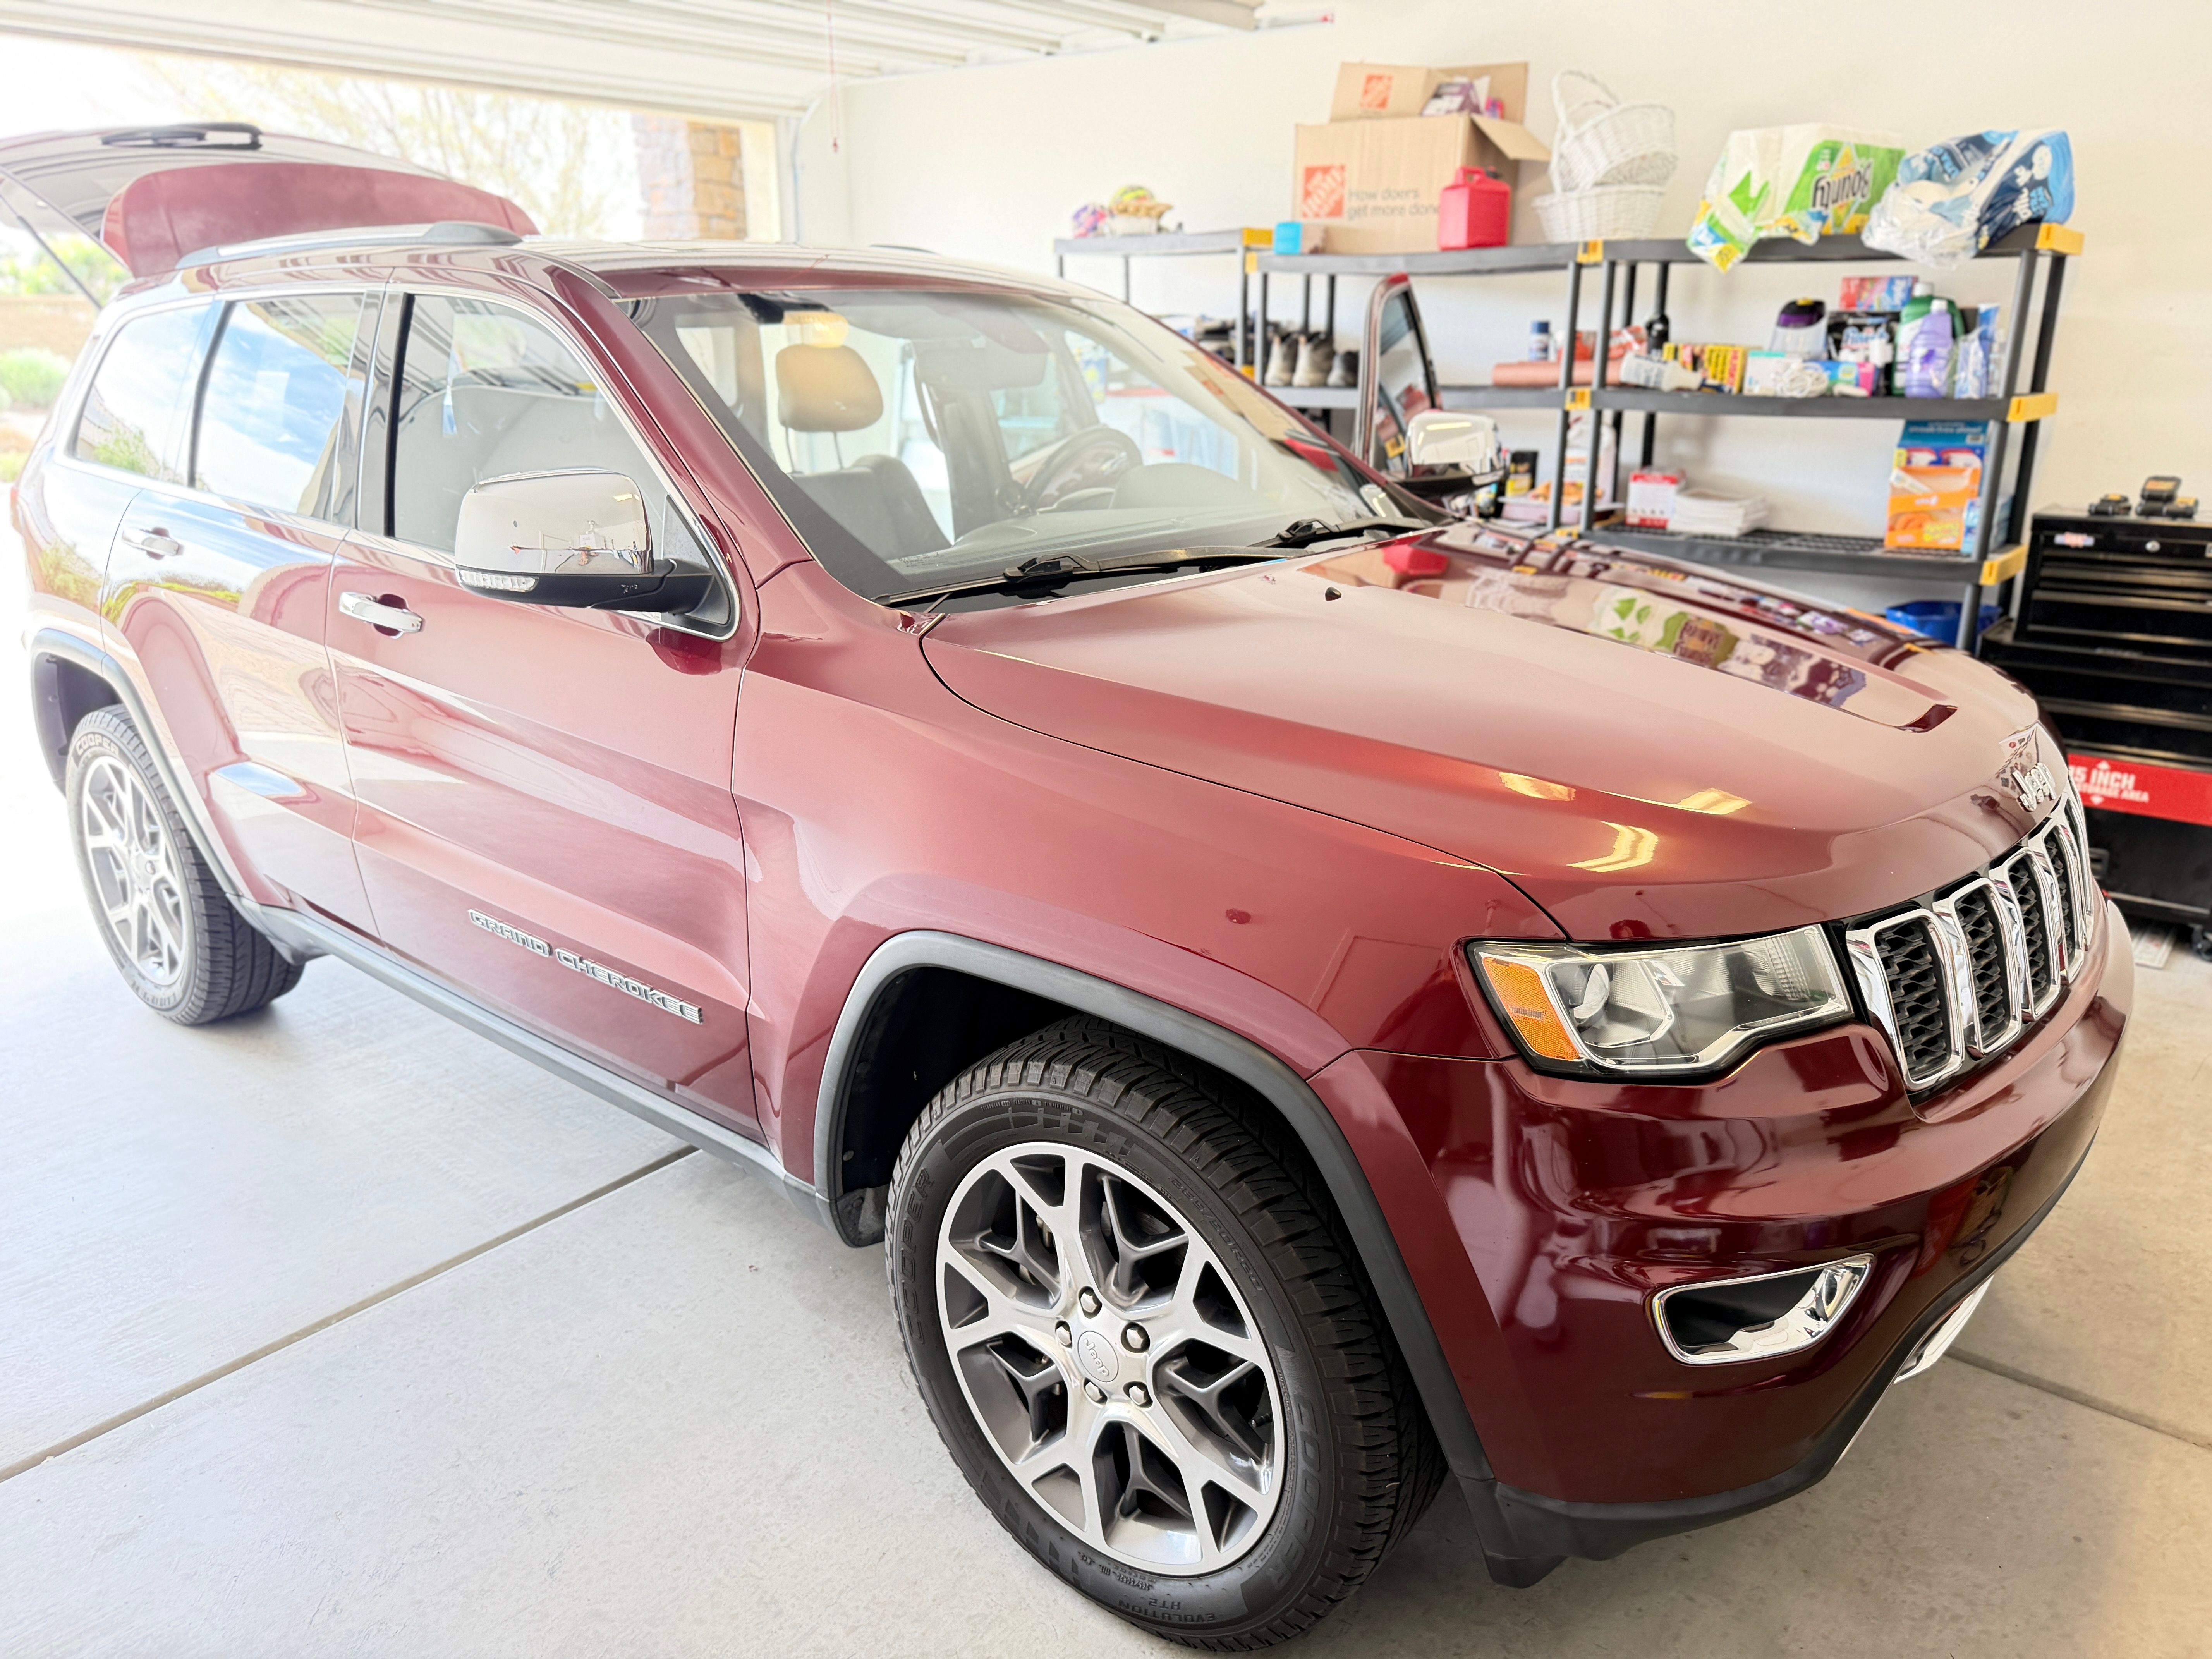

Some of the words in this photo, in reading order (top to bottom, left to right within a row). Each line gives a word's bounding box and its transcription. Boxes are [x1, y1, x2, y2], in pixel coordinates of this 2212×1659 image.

[1348, 189, 1377, 200] How
[1381, 188, 1419, 199] doers
[1813, 163, 1871, 209] Bounty
[1348, 205, 1370, 220] get
[1370, 206, 1406, 216] more
[76, 733, 119, 756] COOPER
[2011, 762, 2057, 812] Jeep
[2090, 768, 2136, 790] INCH
[2121, 789, 2149, 803] AREA
[467, 908, 554, 957] GRAND
[555, 947, 705, 1025] CHEROKEE
[1170, 1177, 1262, 1290] 265/50R20
[900, 1166, 936, 1345] COOPER
[1084, 1338, 1110, 1376] Jeep
[1266, 1400, 1321, 1592] COOPER
[1118, 1599, 1216, 1622] EVOLUTION
[1148, 1597, 1182, 1611] HT2
